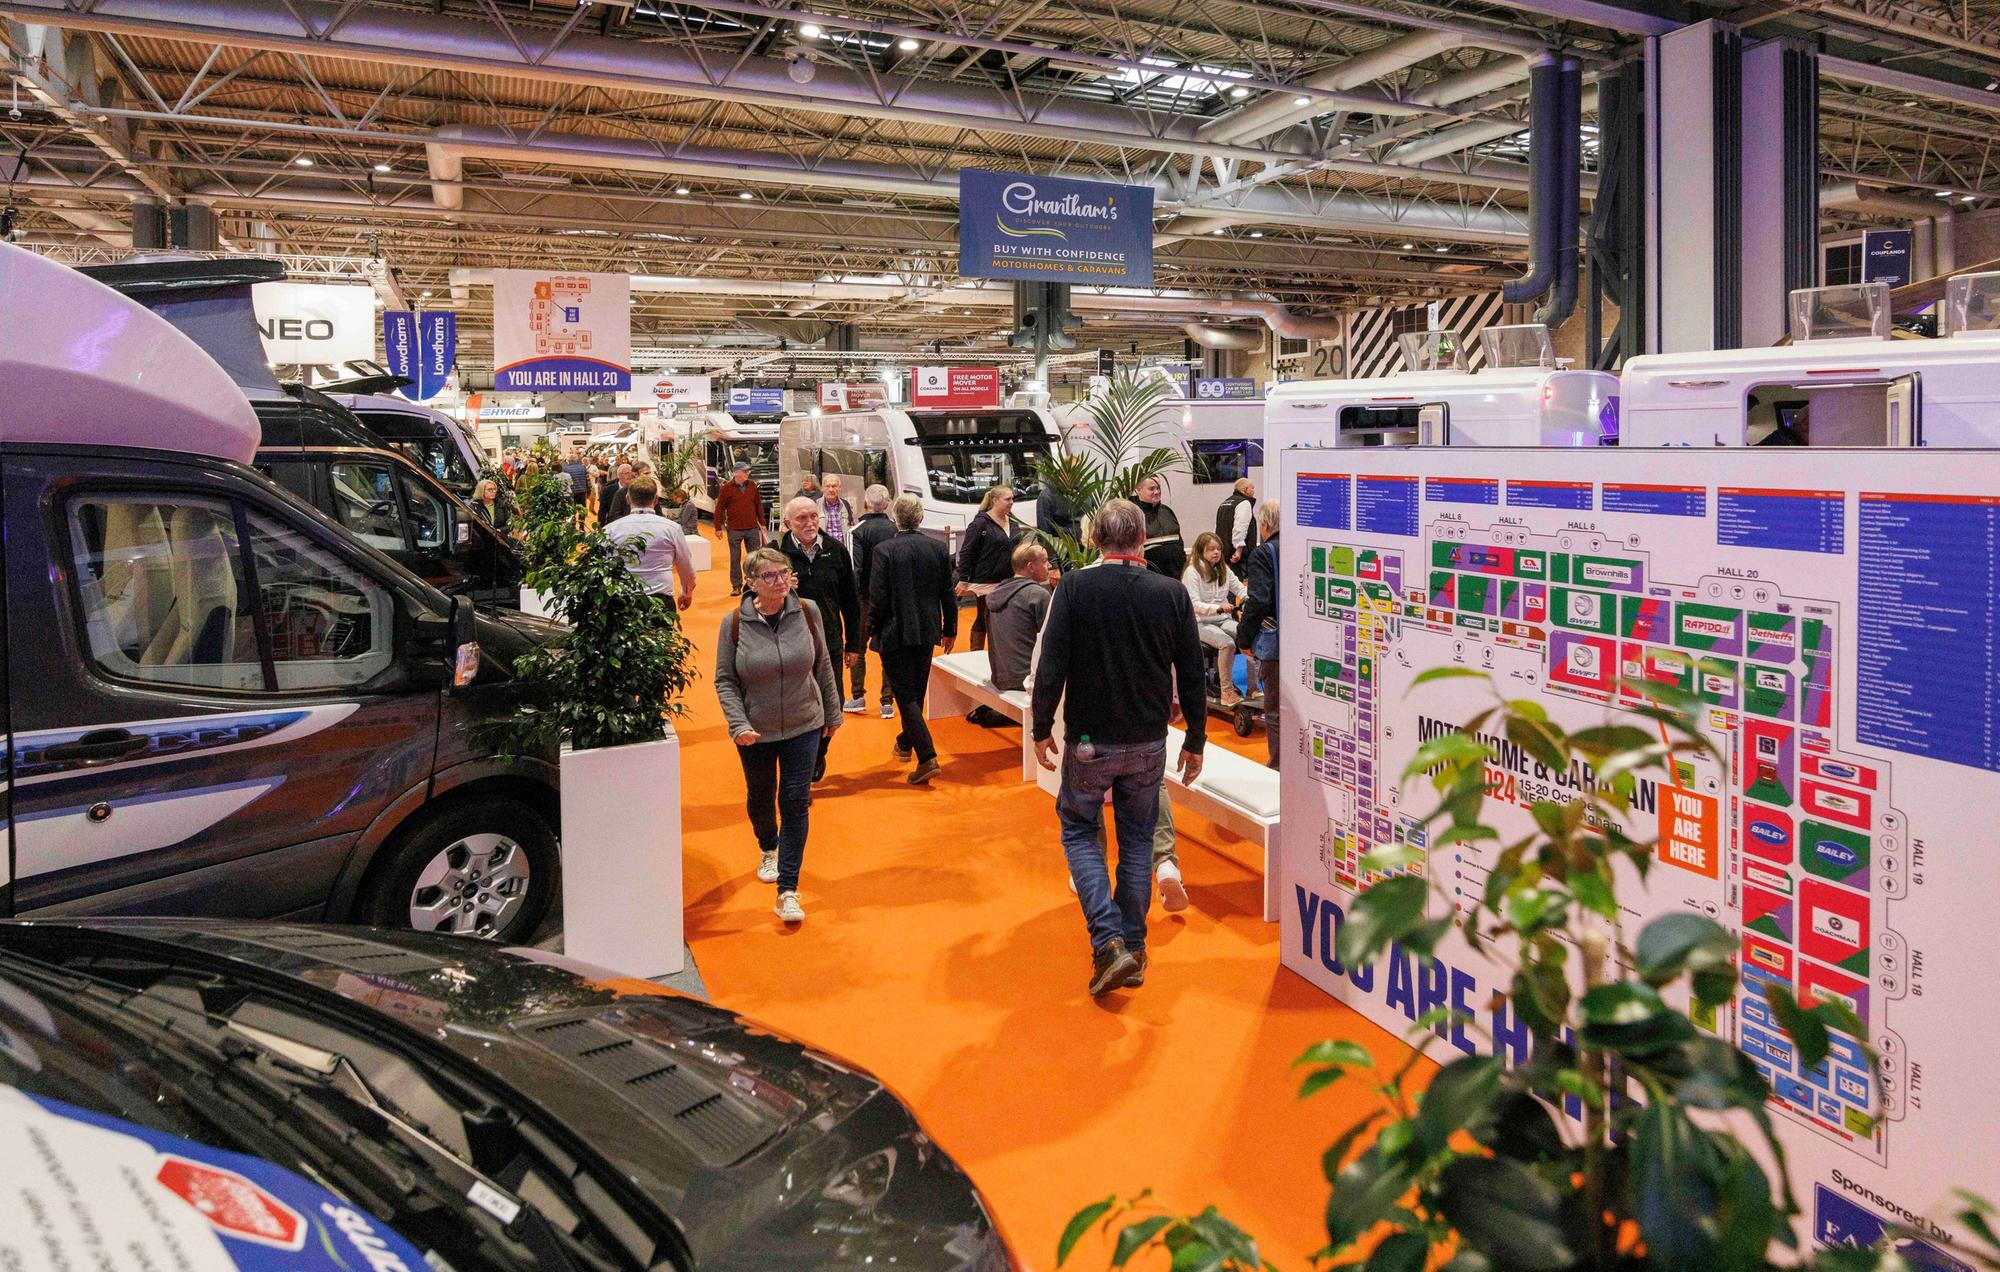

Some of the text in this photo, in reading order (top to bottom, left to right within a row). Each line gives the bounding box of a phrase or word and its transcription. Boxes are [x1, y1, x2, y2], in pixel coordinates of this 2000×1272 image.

[1002, 182, 1118, 220] Grantham's
[994, 244, 1126, 262] BUY WITH CONFIDENCE
[992, 260, 1127, 275] MOTORHOMES & CARAVANS
[396, 318, 408, 376] Lowdhams
[432, 317, 444, 376] Lowdhams
[1314, 344, 1344, 378] 20
[508, 371, 618, 386] YOU ARE IN HALL 20
[1568, 522, 1588, 530] HALL
[1586, 566, 1628, 579] Brownhills
[1718, 567, 1759, 578] HALL 20
[1568, 618, 1599, 626] SWIFT
[1684, 620, 1722, 633] RAPIDO
[1751, 628, 1792, 641] Dethleffs
[1568, 668, 1598, 678] SWIFT
[1758, 680, 1783, 689] LAIKA
[1520, 779, 1549, 796] 15-20
[1672, 792, 1702, 818] YOU
[1673, 817, 1702, 843] ARE
[1751, 825, 1786, 841] BAILEY
[1669, 839, 1706, 869] HERE
[1817, 846, 1854, 862] BAILEY
[1912, 838, 1924, 885] HALL 19
[1295, 884, 1374, 993] YO
[1815, 926, 1857, 944] COACHMAN
[1912, 950, 1922, 996] HALL 18
[1911, 1062, 1922, 1110] HALL 17
[1832, 1168, 1953, 1243] Sponsored by
